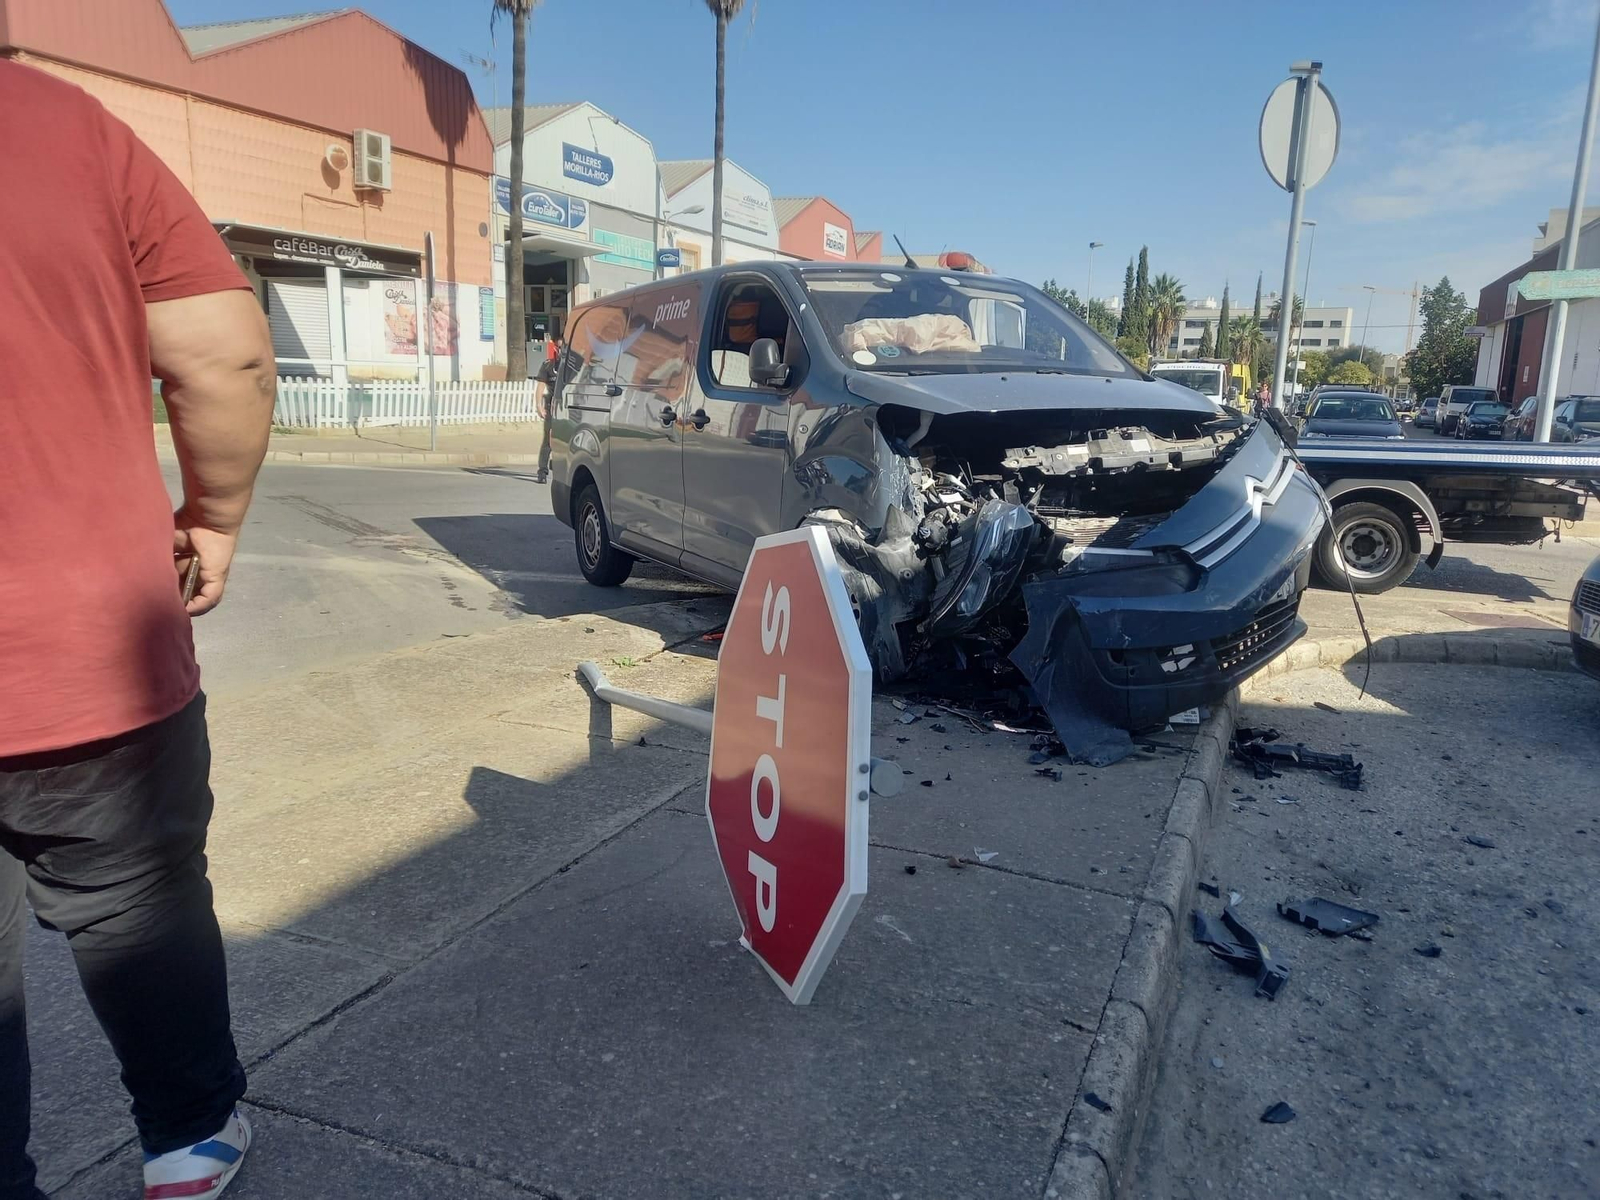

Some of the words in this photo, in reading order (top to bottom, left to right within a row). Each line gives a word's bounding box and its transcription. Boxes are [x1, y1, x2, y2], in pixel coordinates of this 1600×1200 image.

[571, 150, 602, 169] TALLERES
[564, 161, 610, 182] MORILLA-RIOS
[527, 200, 559, 218] EuroTaller
[273, 237, 333, 256] caféBar
[346, 256, 385, 271] Daniela
[652, 295, 691, 330] prime
[748, 579, 791, 932] STOP
